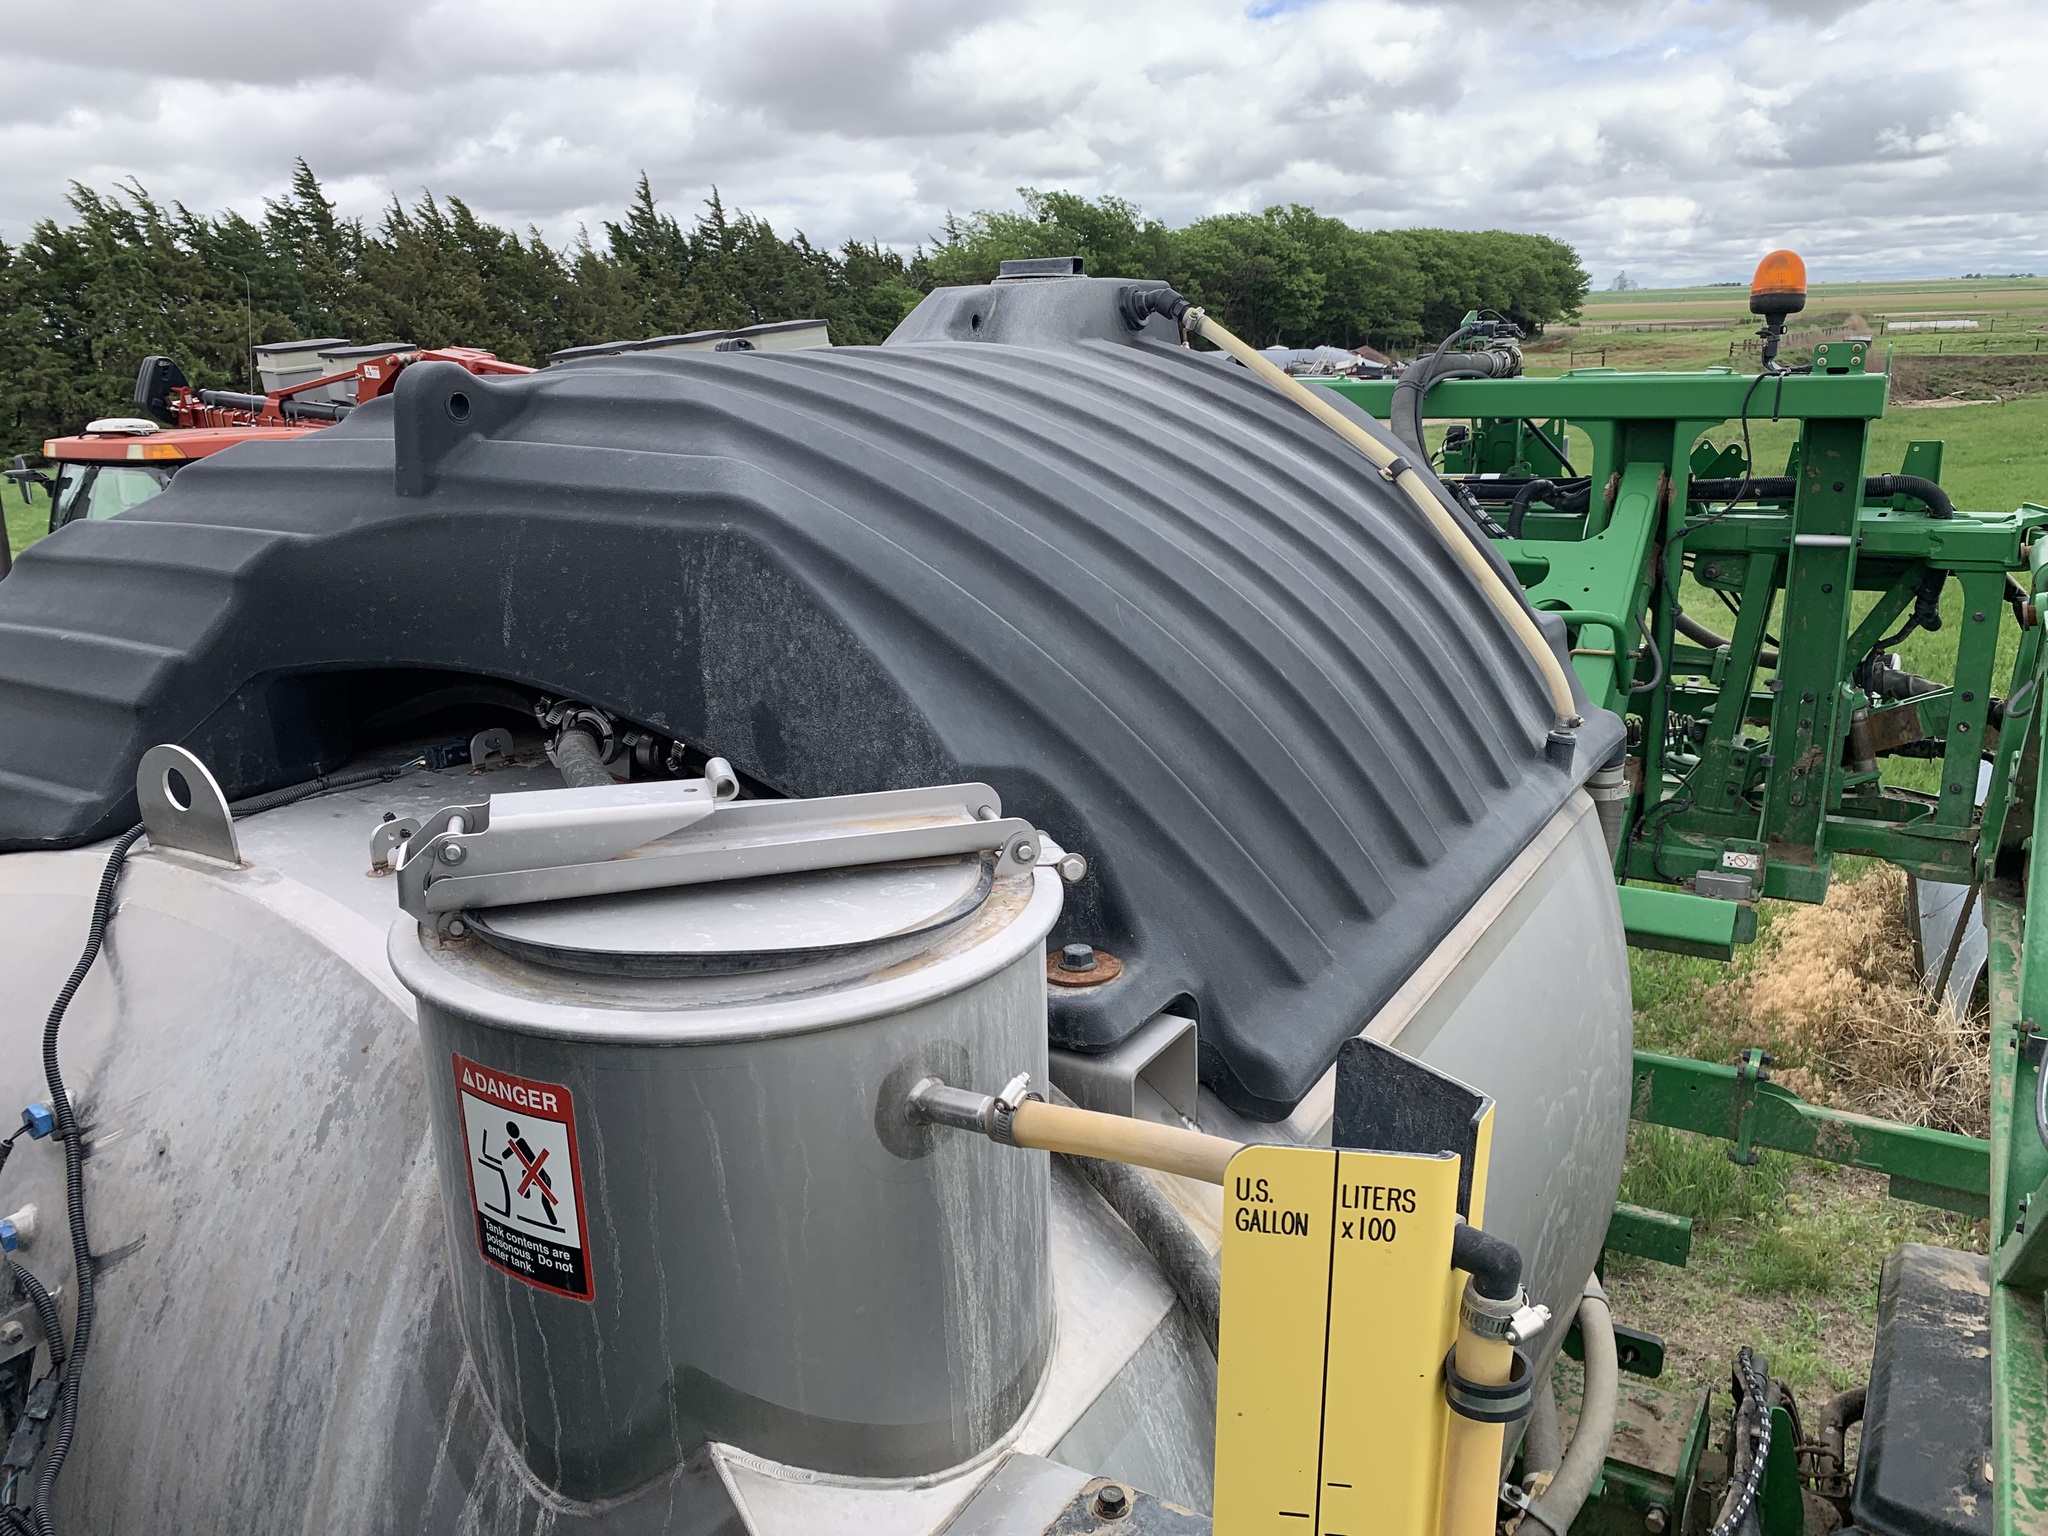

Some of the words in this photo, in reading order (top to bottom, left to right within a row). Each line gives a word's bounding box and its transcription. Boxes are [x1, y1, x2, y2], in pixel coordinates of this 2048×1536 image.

[475, 1072, 558, 1113] DANGER
[1236, 1177, 1273, 1203] U.S.
[1342, 1184, 1416, 1213] LITERS
[1235, 1207, 1309, 1236] GALLON
[1341, 1216, 1396, 1242] x100
[484, 1218, 504, 1238] Tank
[506, 1232, 550, 1255] contents
[552, 1248, 571, 1260] are
[486, 1233, 534, 1261] poisonous.
[537, 1254, 553, 1267] Do
[555, 1260, 574, 1273] not
[488, 1244, 509, 1262] enter
[511, 1255, 535, 1273] tank.
